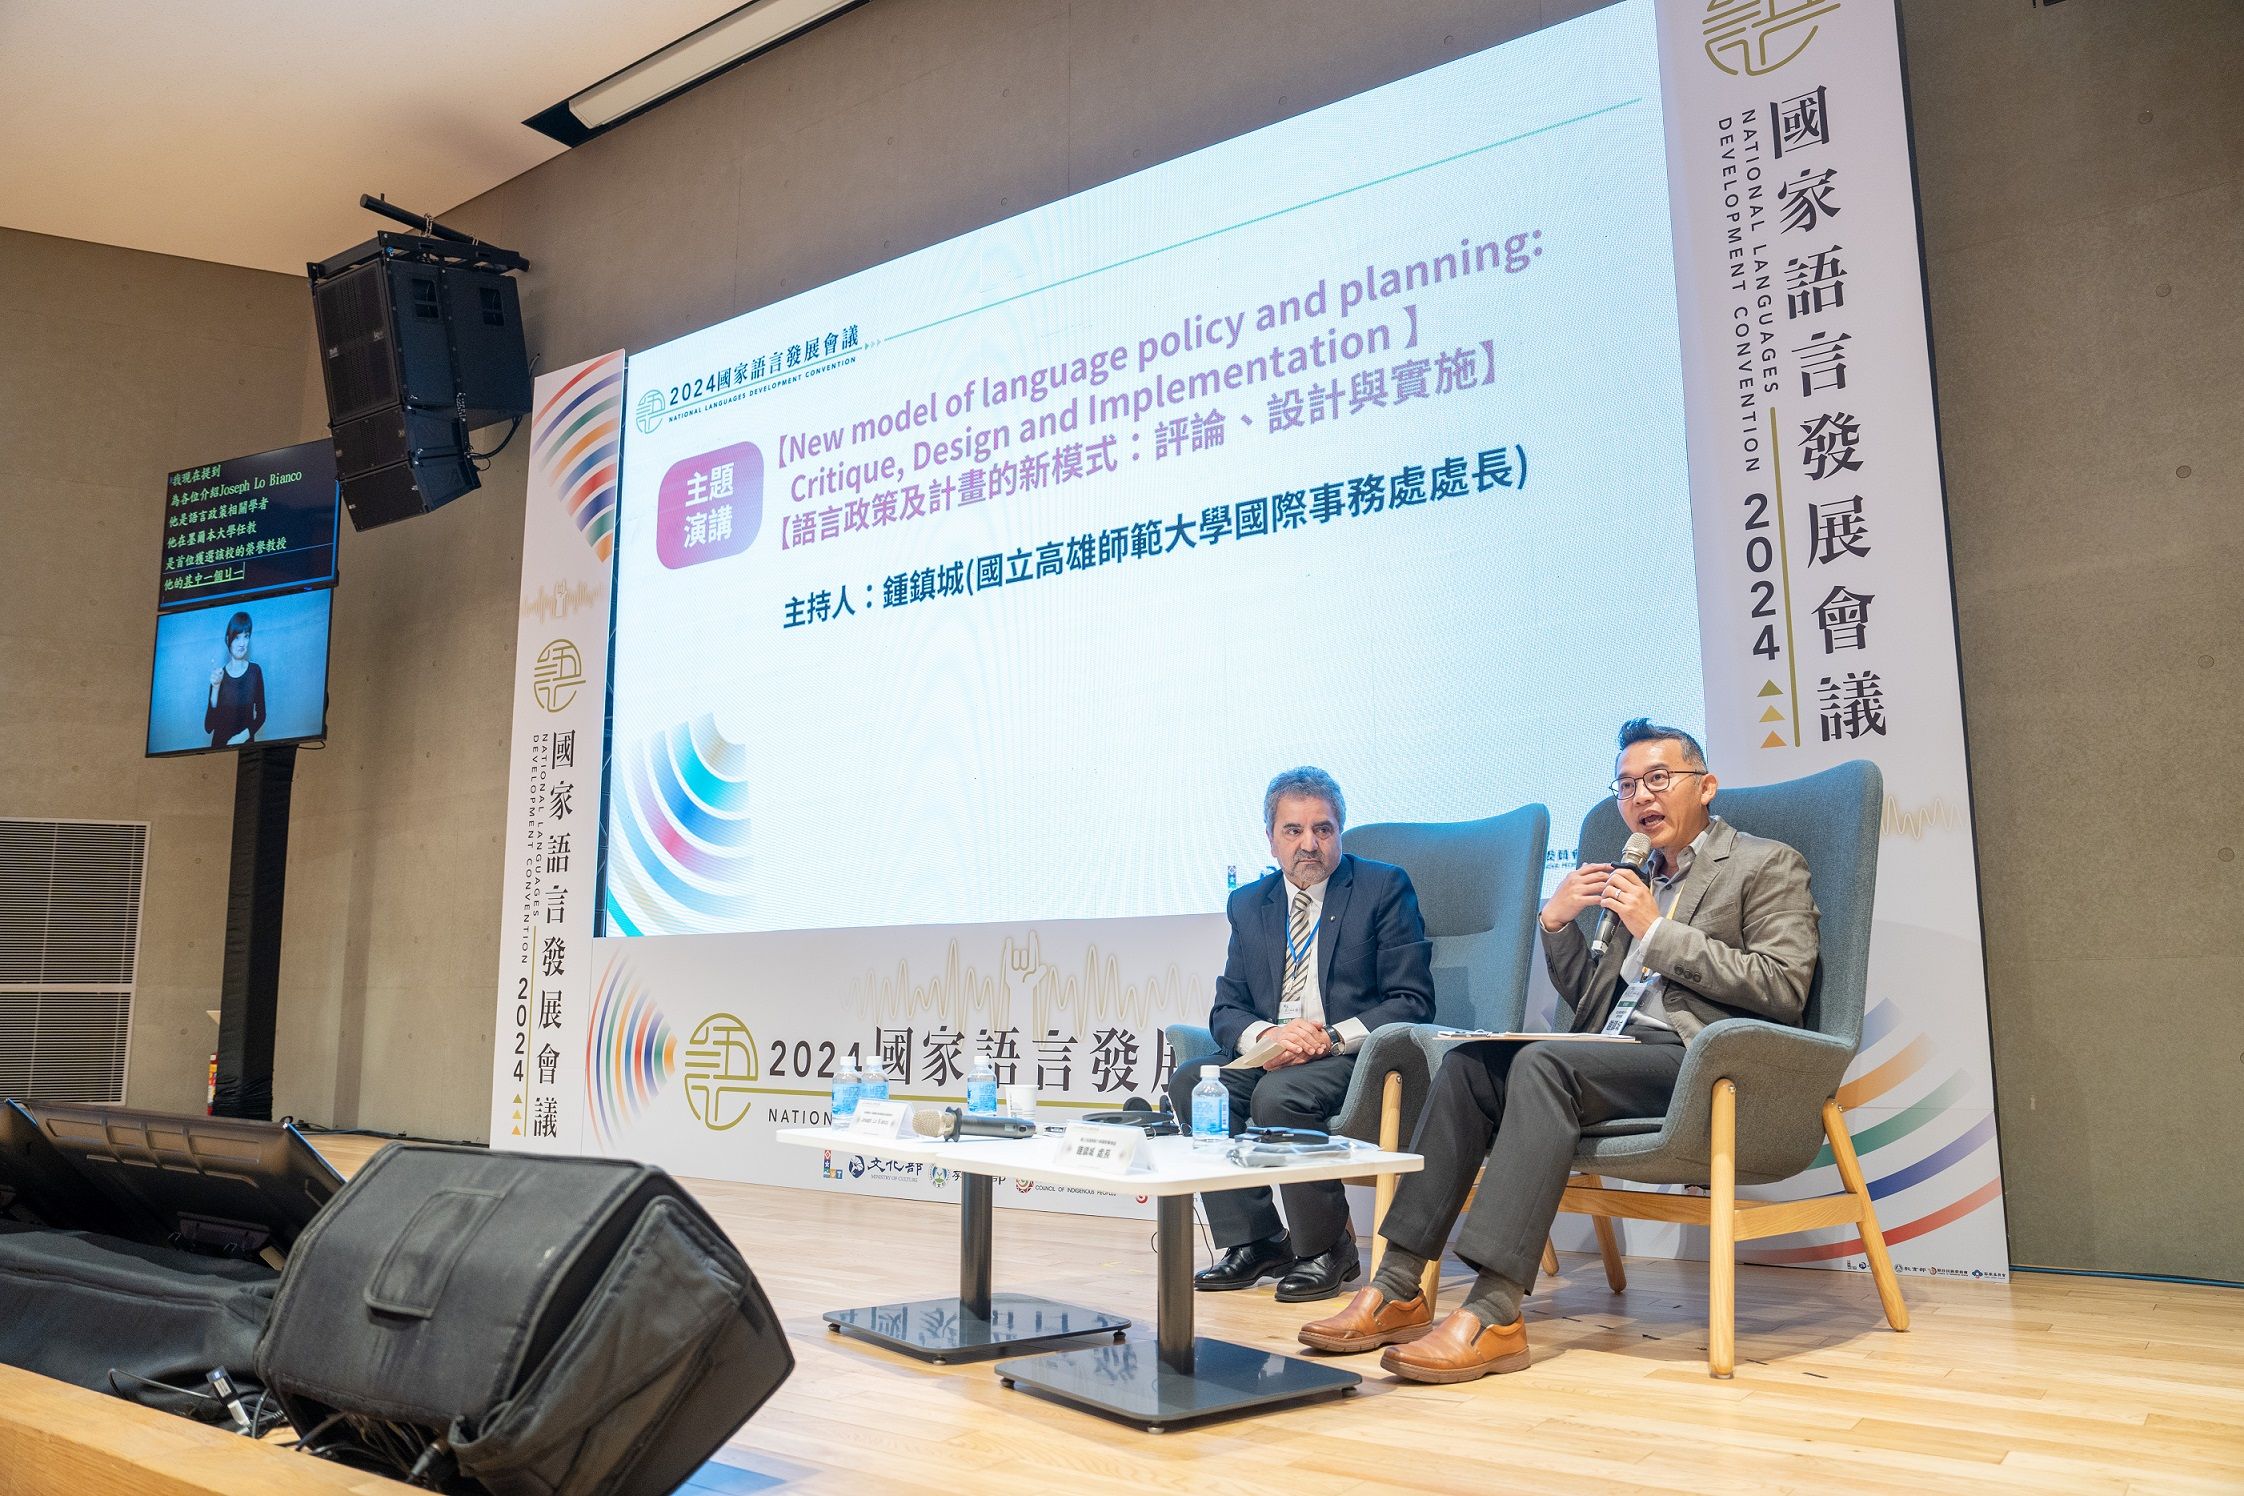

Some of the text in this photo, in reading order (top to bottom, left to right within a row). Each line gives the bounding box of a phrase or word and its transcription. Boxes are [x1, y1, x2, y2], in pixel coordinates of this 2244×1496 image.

[852, 391, 937, 445] model
[946, 379, 976, 419] of
[983, 344, 1127, 408] language
[1139, 312, 1246, 372] policy
[1256, 280, 1326, 331] and
[1340, 229, 1543, 317] planning:
[1741, 108, 1779, 393] NATIONAL LANGUAGES
[669, 357, 856, 423] NATIONAL LANGUAGES DEVELOPMENT CONVENTION
[791, 456, 904, 502] Critique,
[914, 425, 1010, 471] Design
[1020, 398, 1078, 443] and
[1089, 323, 1390, 425] Implementation
[1718, 116, 1781, 661] DEVELOPMENT CONVENTION 2024
[1769, 85, 1887, 742] 國家語言發展會議
[254, 477, 265, 489] Lo
[269, 470, 302, 487] Bianco
[683, 505, 733, 549] 演講
[685, 462, 734, 507] 主題
[513, 734, 539, 1082] DEVELOPMENT CONVENTION 2024
[532, 733, 548, 917] NATIONAL LANGUAGES
[533, 729, 576, 1138] 國家語言發展會議
[867, 1157, 923, 1176] 文化部
[1035, 1184, 1056, 1192] COUNCIL
